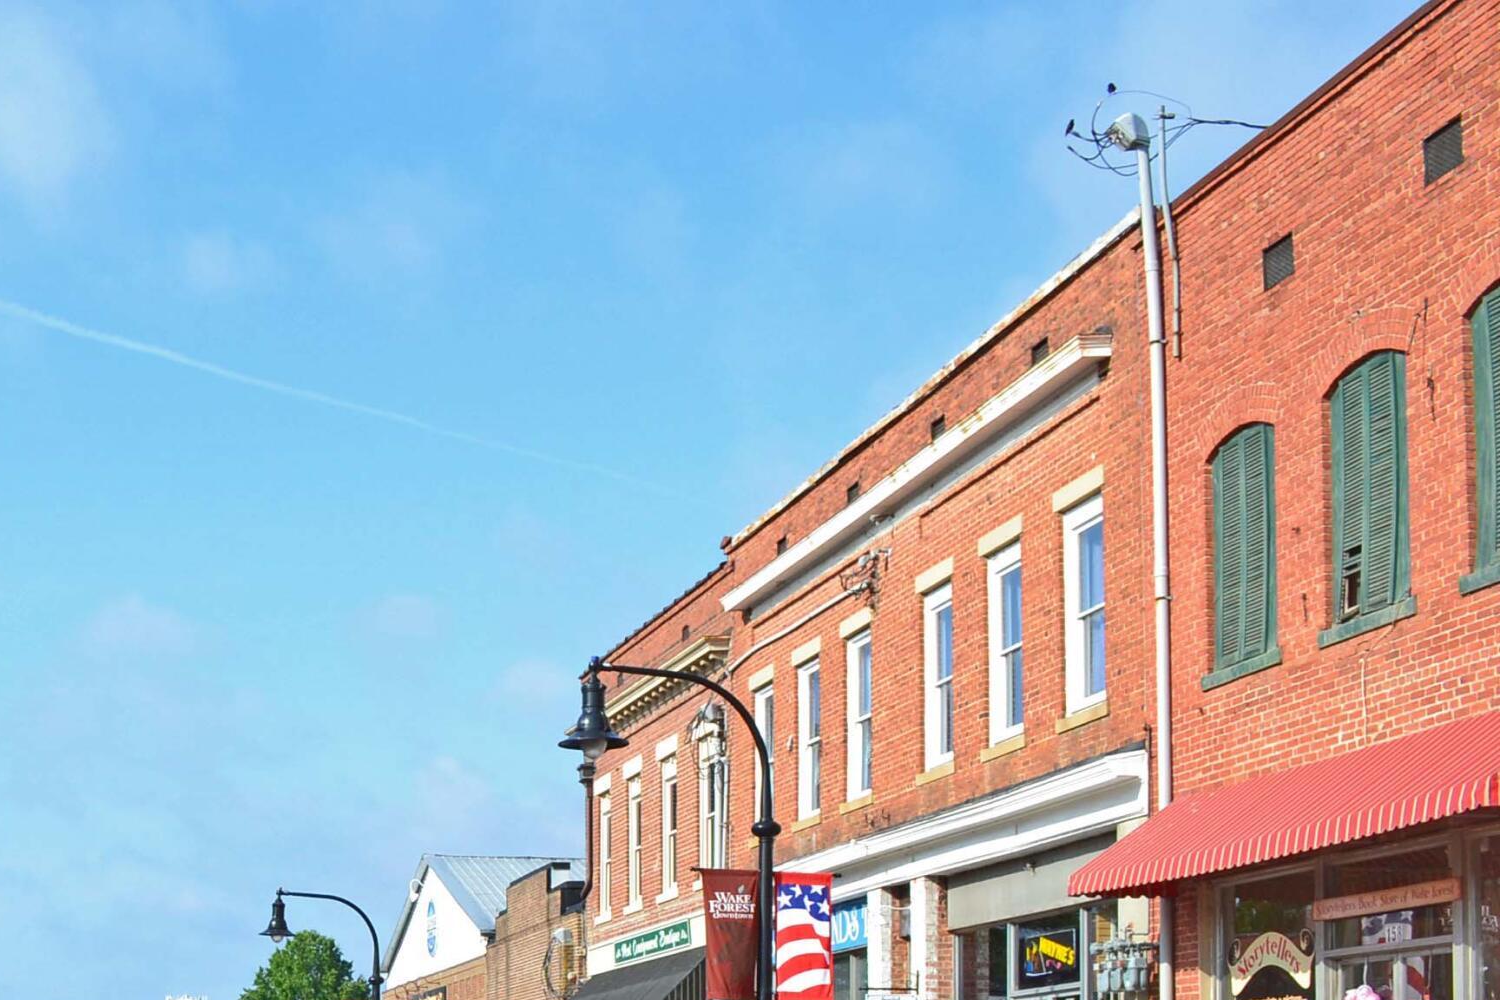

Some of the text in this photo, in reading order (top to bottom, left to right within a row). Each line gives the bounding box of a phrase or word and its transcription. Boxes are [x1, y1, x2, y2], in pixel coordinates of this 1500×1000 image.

[714, 891, 751, 903] WAKE
[708, 900, 756, 913] FOREST
[712, 911, 754, 920] downtown
[1237, 936, 1301, 979] Storytellers
